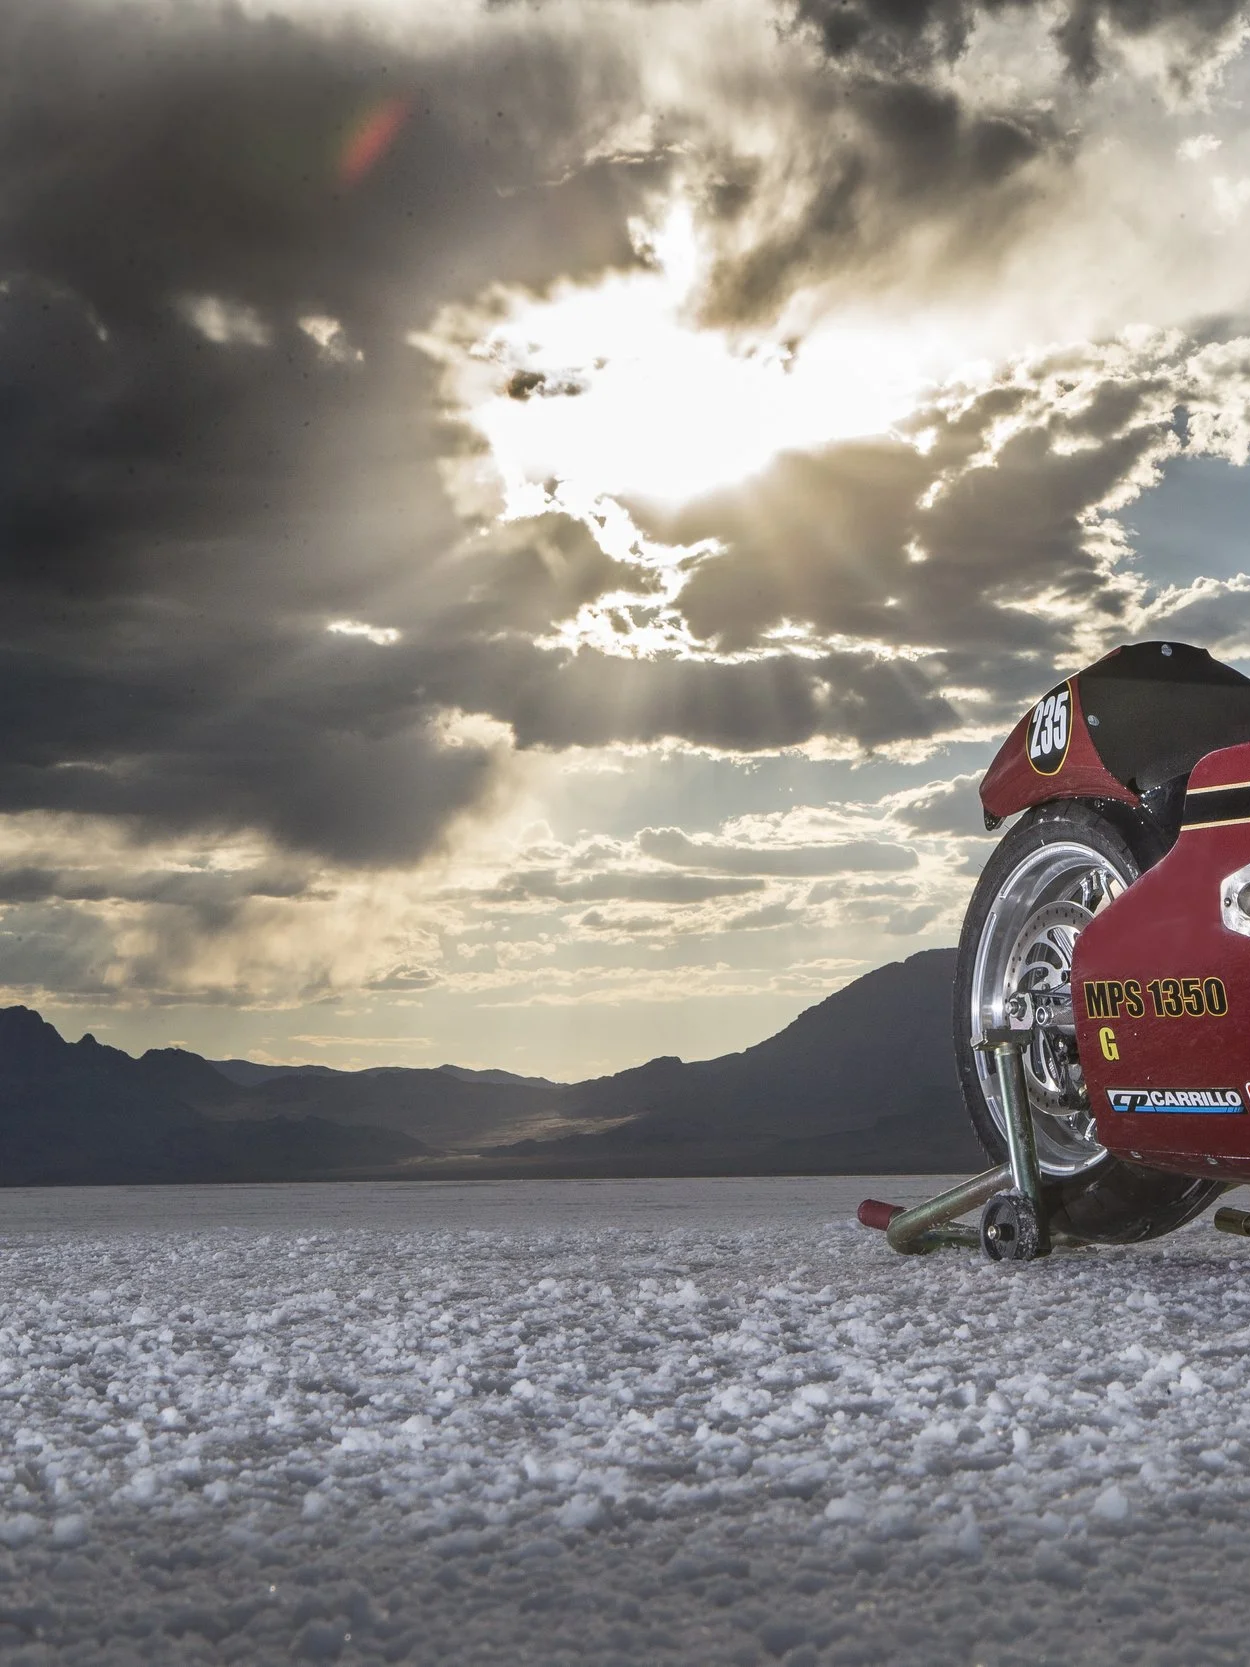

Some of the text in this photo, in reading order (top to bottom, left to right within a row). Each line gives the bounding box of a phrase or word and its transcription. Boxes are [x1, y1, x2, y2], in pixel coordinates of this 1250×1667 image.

[1030, 690, 1070, 760] 235
[1084, 976, 1228, 1019] MPS 1350
[1099, 1027, 1119, 1061] G
[1150, 1090, 1242, 1107] CARRILLO
